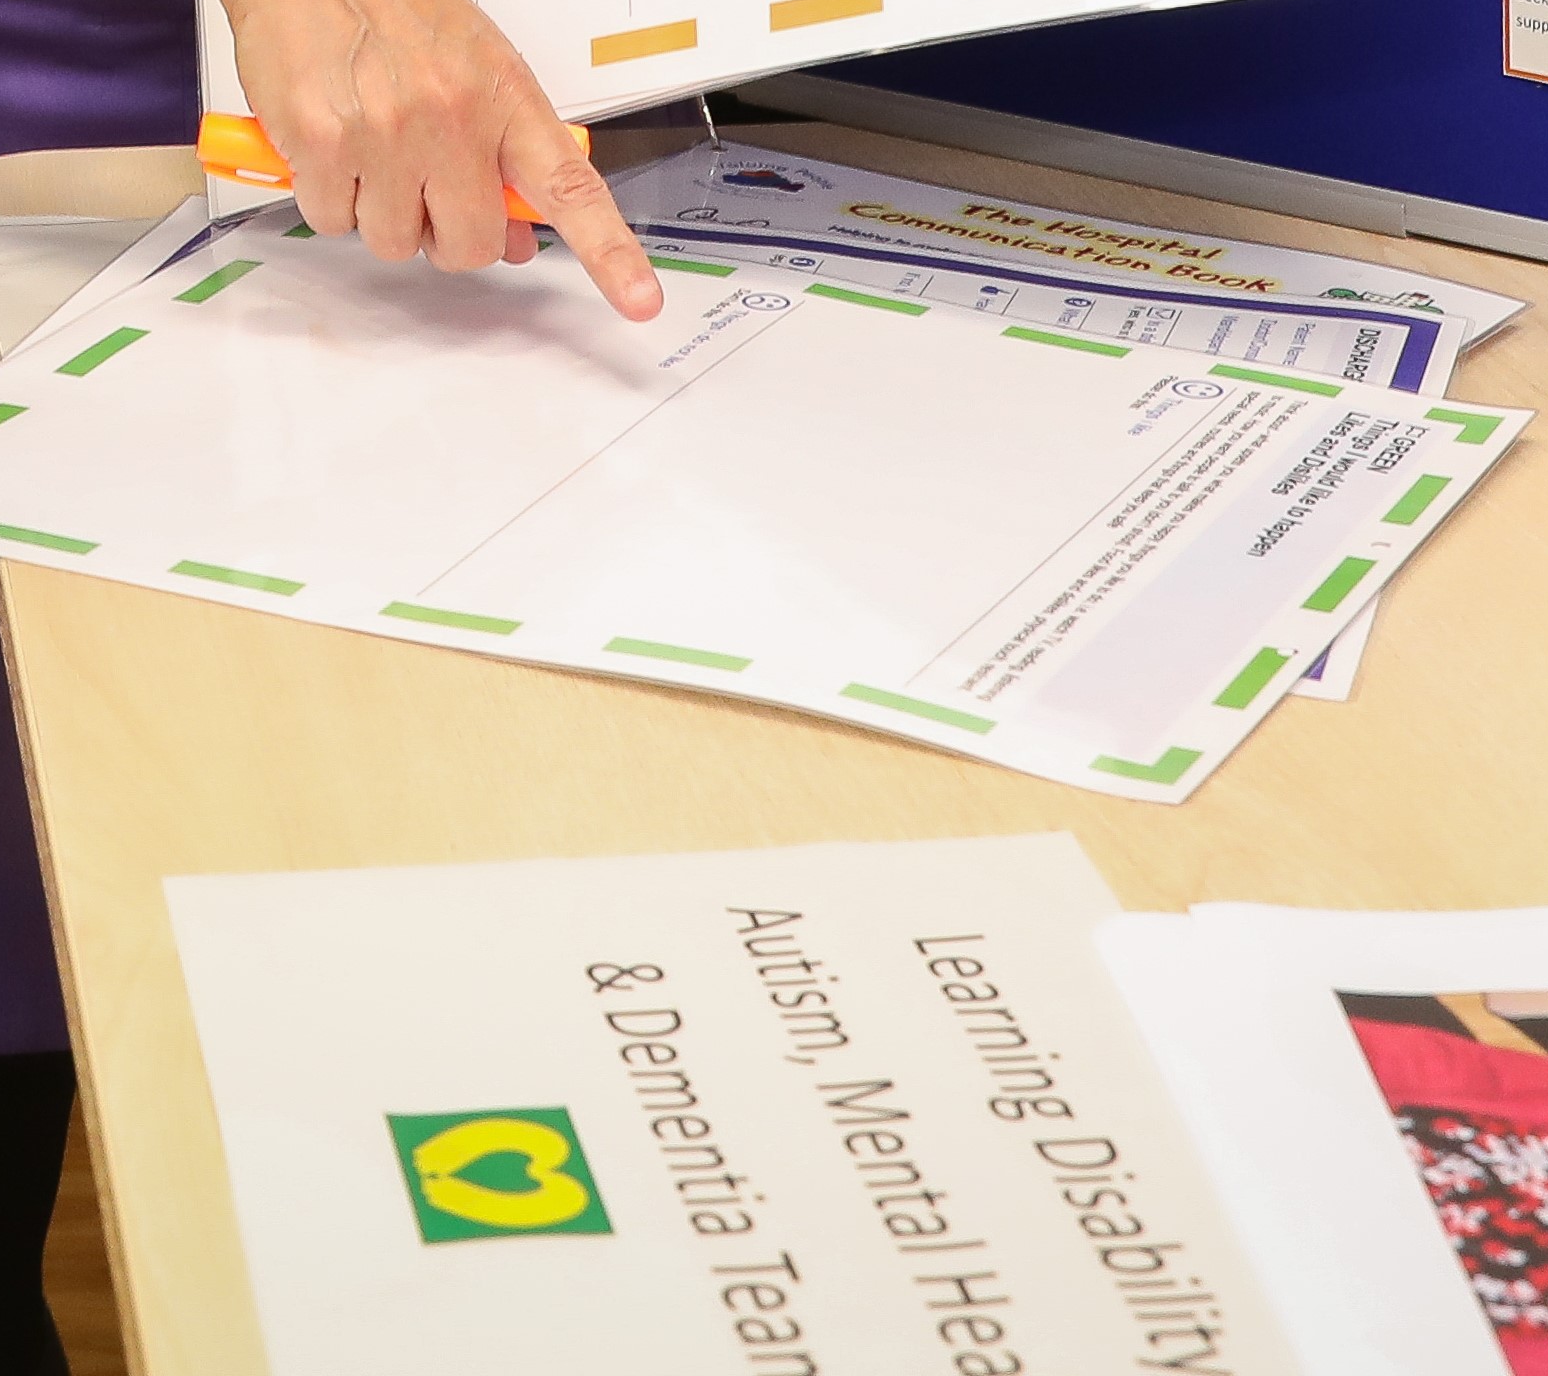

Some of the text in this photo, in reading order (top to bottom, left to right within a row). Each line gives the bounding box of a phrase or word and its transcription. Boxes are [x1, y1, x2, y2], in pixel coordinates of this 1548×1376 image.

[849, 202, 1153, 271] Communication
[1167, 264, 1275, 294] Book
[962, 203, 1222, 261] The Hospital
[1247, 419, 1401, 558] Things I would like to happen
[1271, 411, 1371, 496] Likes and Dislikes
[1367, 438, 1416, 474] GREEN
[588, 959, 665, 996] &
[603, 1005, 766, 1240] Dementia
[723, 902, 854, 1070] Autism,
[815, 1074, 993, 1255] Mental
[912, 931, 1236, 1376] Learning Disability
